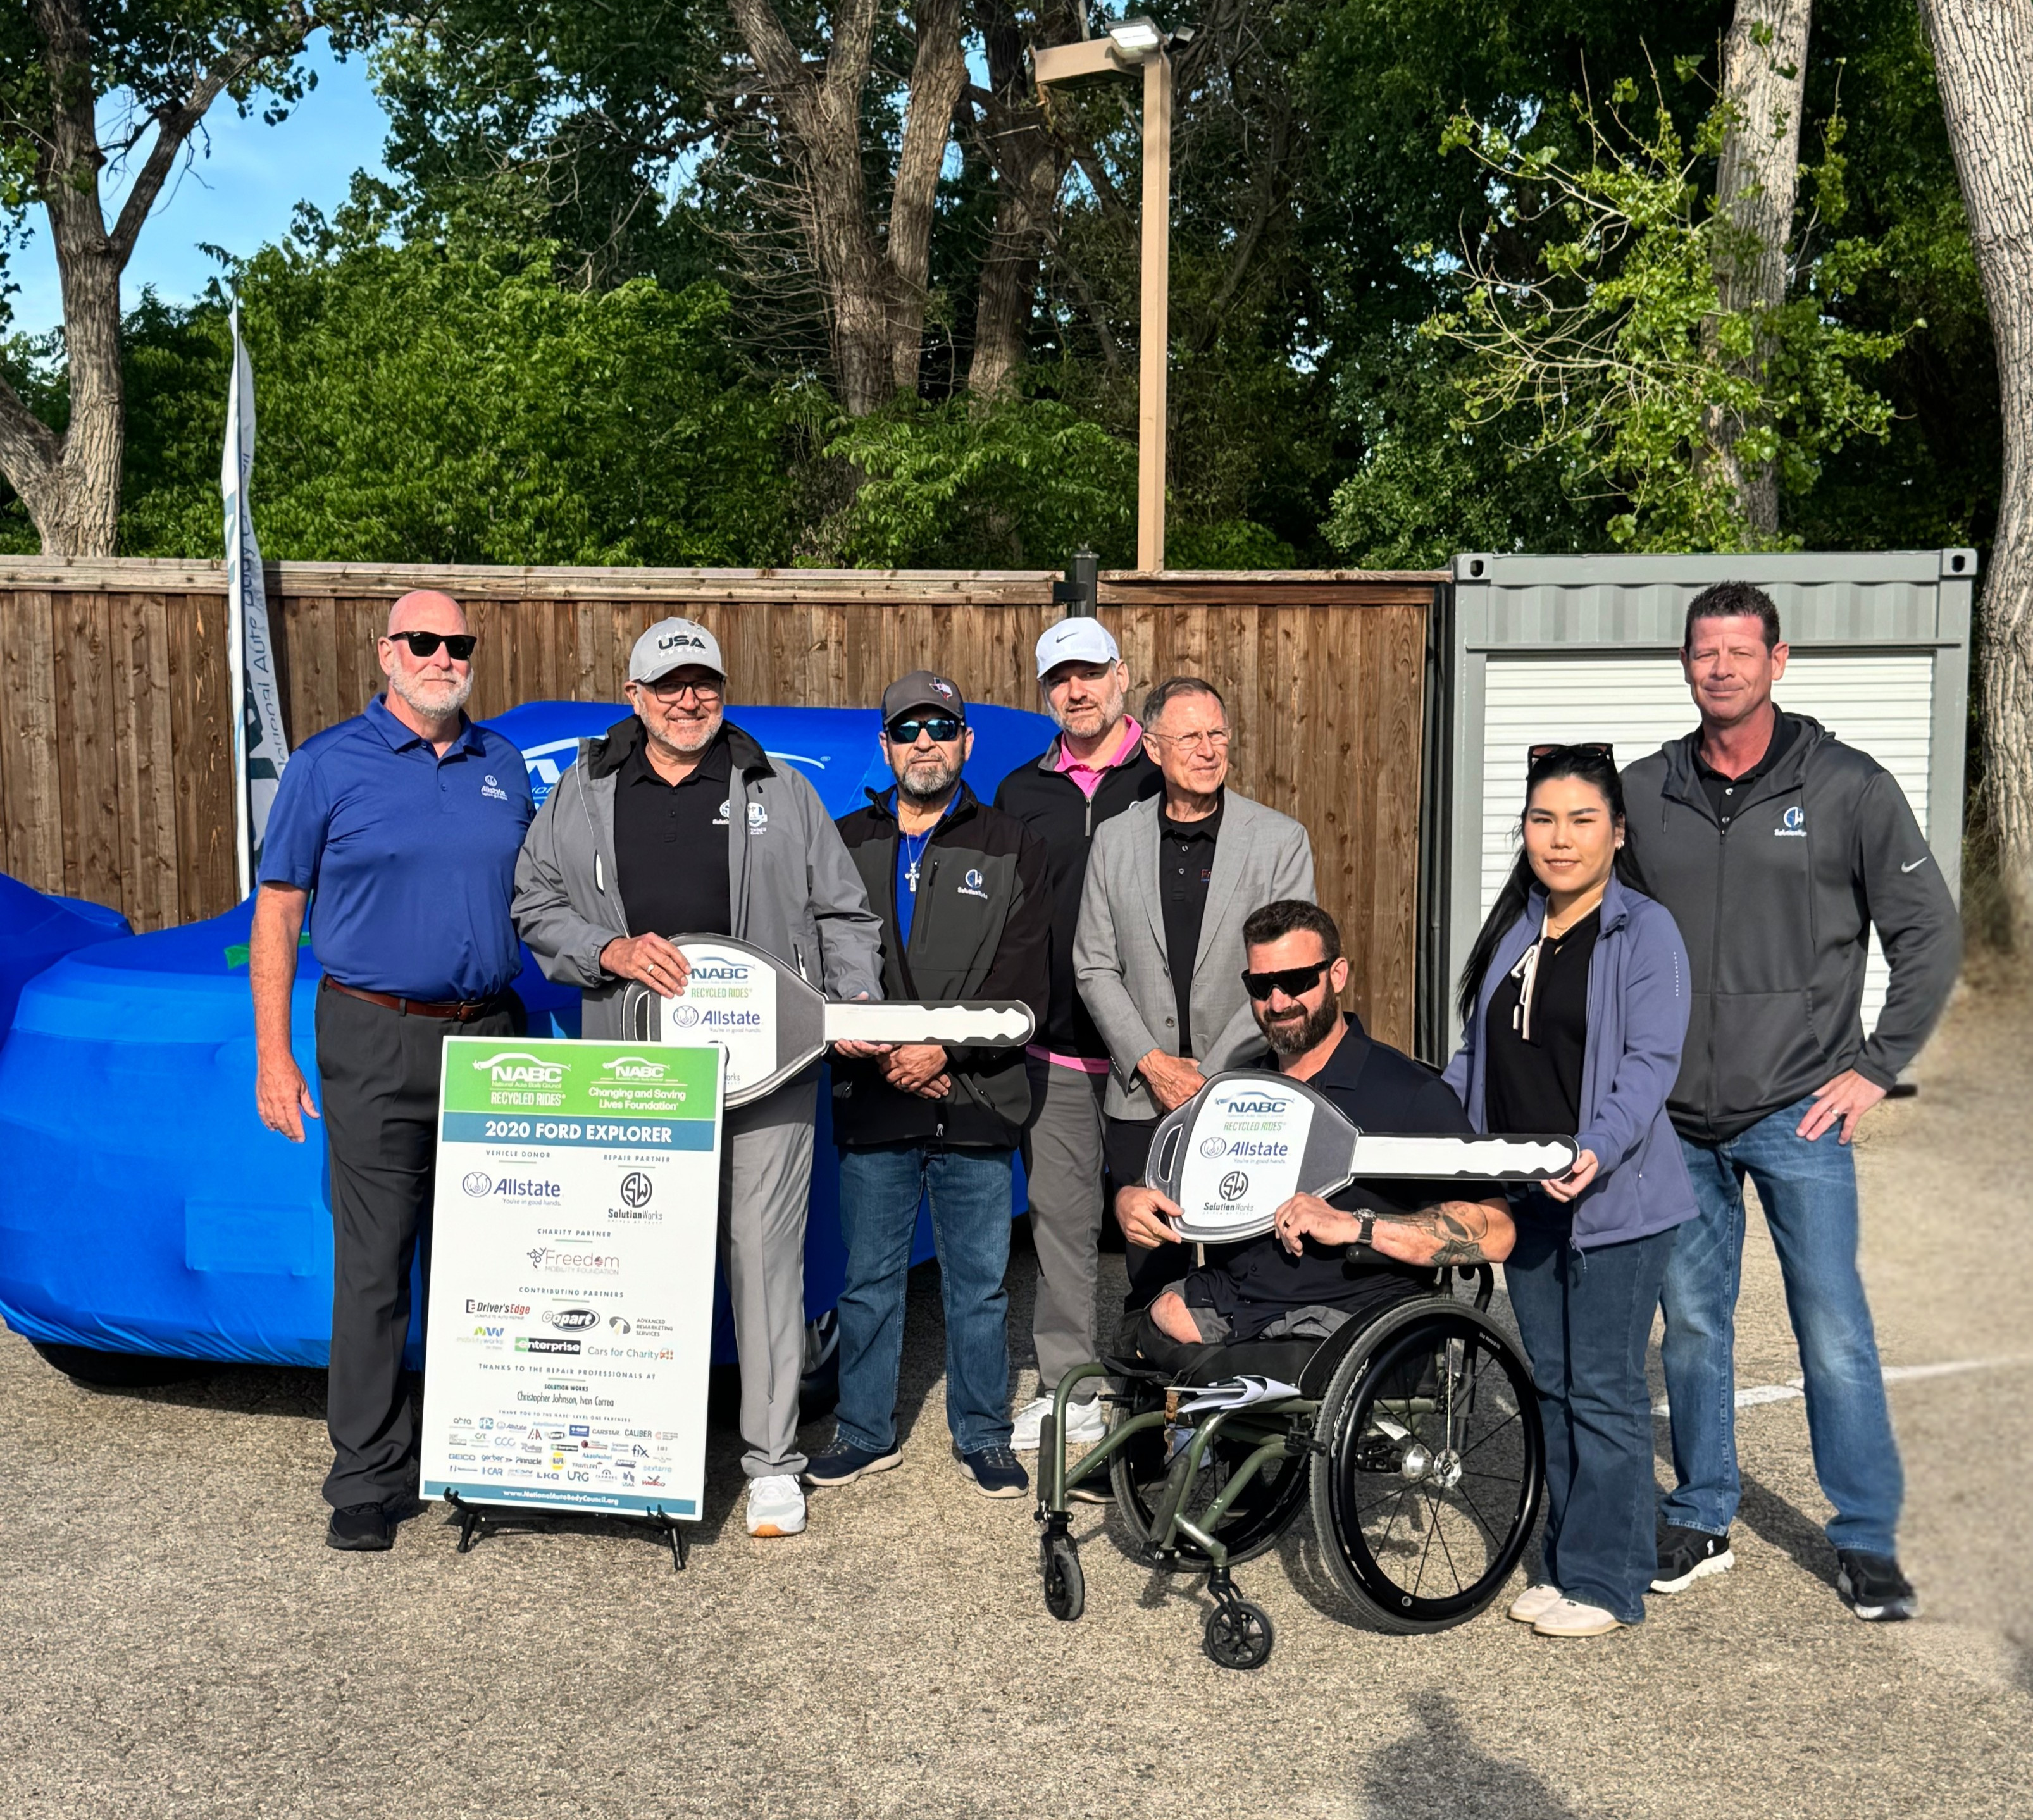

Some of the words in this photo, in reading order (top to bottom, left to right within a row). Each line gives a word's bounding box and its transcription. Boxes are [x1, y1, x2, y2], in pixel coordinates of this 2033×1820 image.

[658, 635, 706, 650] USA
[691, 968, 748, 979] NABC
[692, 988, 726, 998] RECYCLED
[701, 1010, 761, 1025] Allstate
[492, 1066, 562, 1082] NABC
[616, 1066, 664, 1077] NABC
[491, 1091, 534, 1105] RECYCLED
[588, 1087, 633, 1099] Changing
[635, 1089, 652, 1098] and
[654, 1089, 686, 1101] Saving
[599, 1099, 623, 1109] Lives
[625, 1100, 677, 1111] Foundation
[1228, 1102, 1286, 1113] NABC
[485, 1120, 530, 1137] 2020
[535, 1122, 581, 1139] FORD
[586, 1124, 672, 1142] EXPLORER
[1224, 1122, 1260, 1131] RECYCLED
[1226, 1141, 1288, 1156] Allstate
[494, 1179, 561, 1197] Allstate
[608, 1208, 662, 1220] SolutionWorks
[576, 1267, 619, 1275] FOUNDATION
[519, 1287, 580, 1296] CONTRIBUTING
[542, 1310, 592, 1326] Copart
[518, 1340, 580, 1352] enterprise
[588, 1346, 608, 1356] Cars
[611, 1347, 624, 1356] for
[626, 1348, 659, 1360] Charity
[578, 1369, 642, 1379] PROFESSIONALS
[517, 1391, 550, 1404] Christopher
[552, 1393, 578, 1406] Johnson,
[594, 1396, 614, 1407] Correa
[625, 1428, 652, 1438] CALIBER
[495, 1437, 516, 1447] CCC
[448, 1453, 476, 1461] GEICO
[481, 1454, 505, 1463] gerber
[516, 1456, 542, 1466] Pinnacle
[537, 1472, 559, 1480] LKQ
[567, 1470, 590, 1482] URG
[503, 1490, 619, 1506] www.NationalAutoBodyCouncil.org
